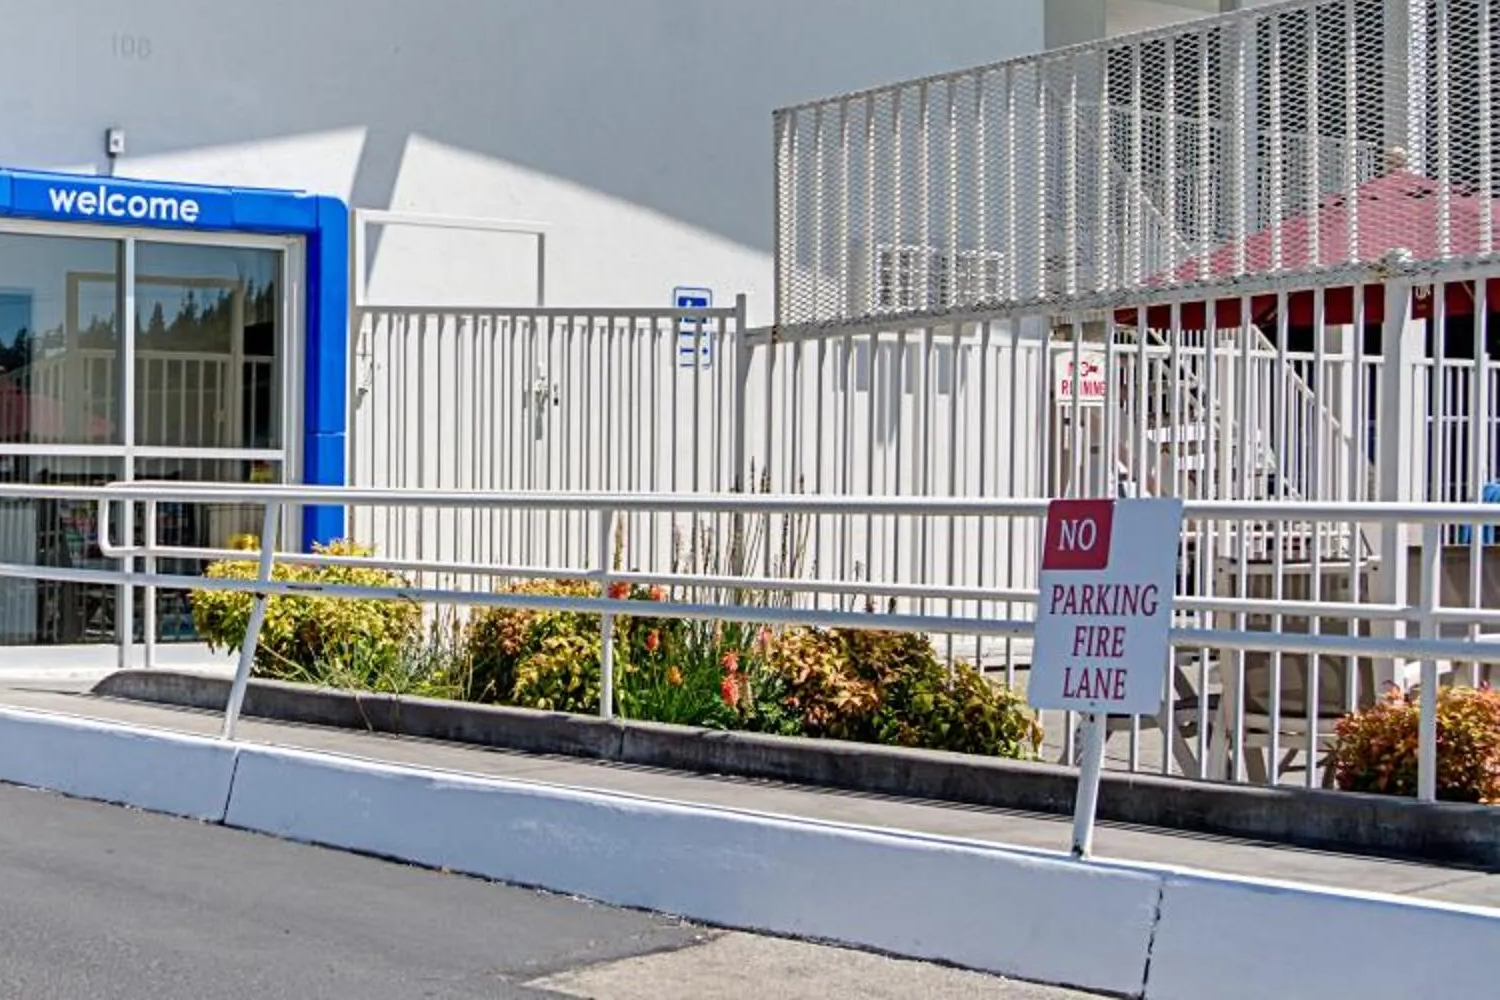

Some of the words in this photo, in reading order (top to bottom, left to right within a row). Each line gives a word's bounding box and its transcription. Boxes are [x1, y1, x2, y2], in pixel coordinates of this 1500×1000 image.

[49, 185, 200, 223] welcome
[1058, 519, 1097, 552] NO
[1049, 583, 1160, 617] PARKING
[1072, 626, 1127, 658] FIRE
[1061, 667, 1128, 701] LANE
